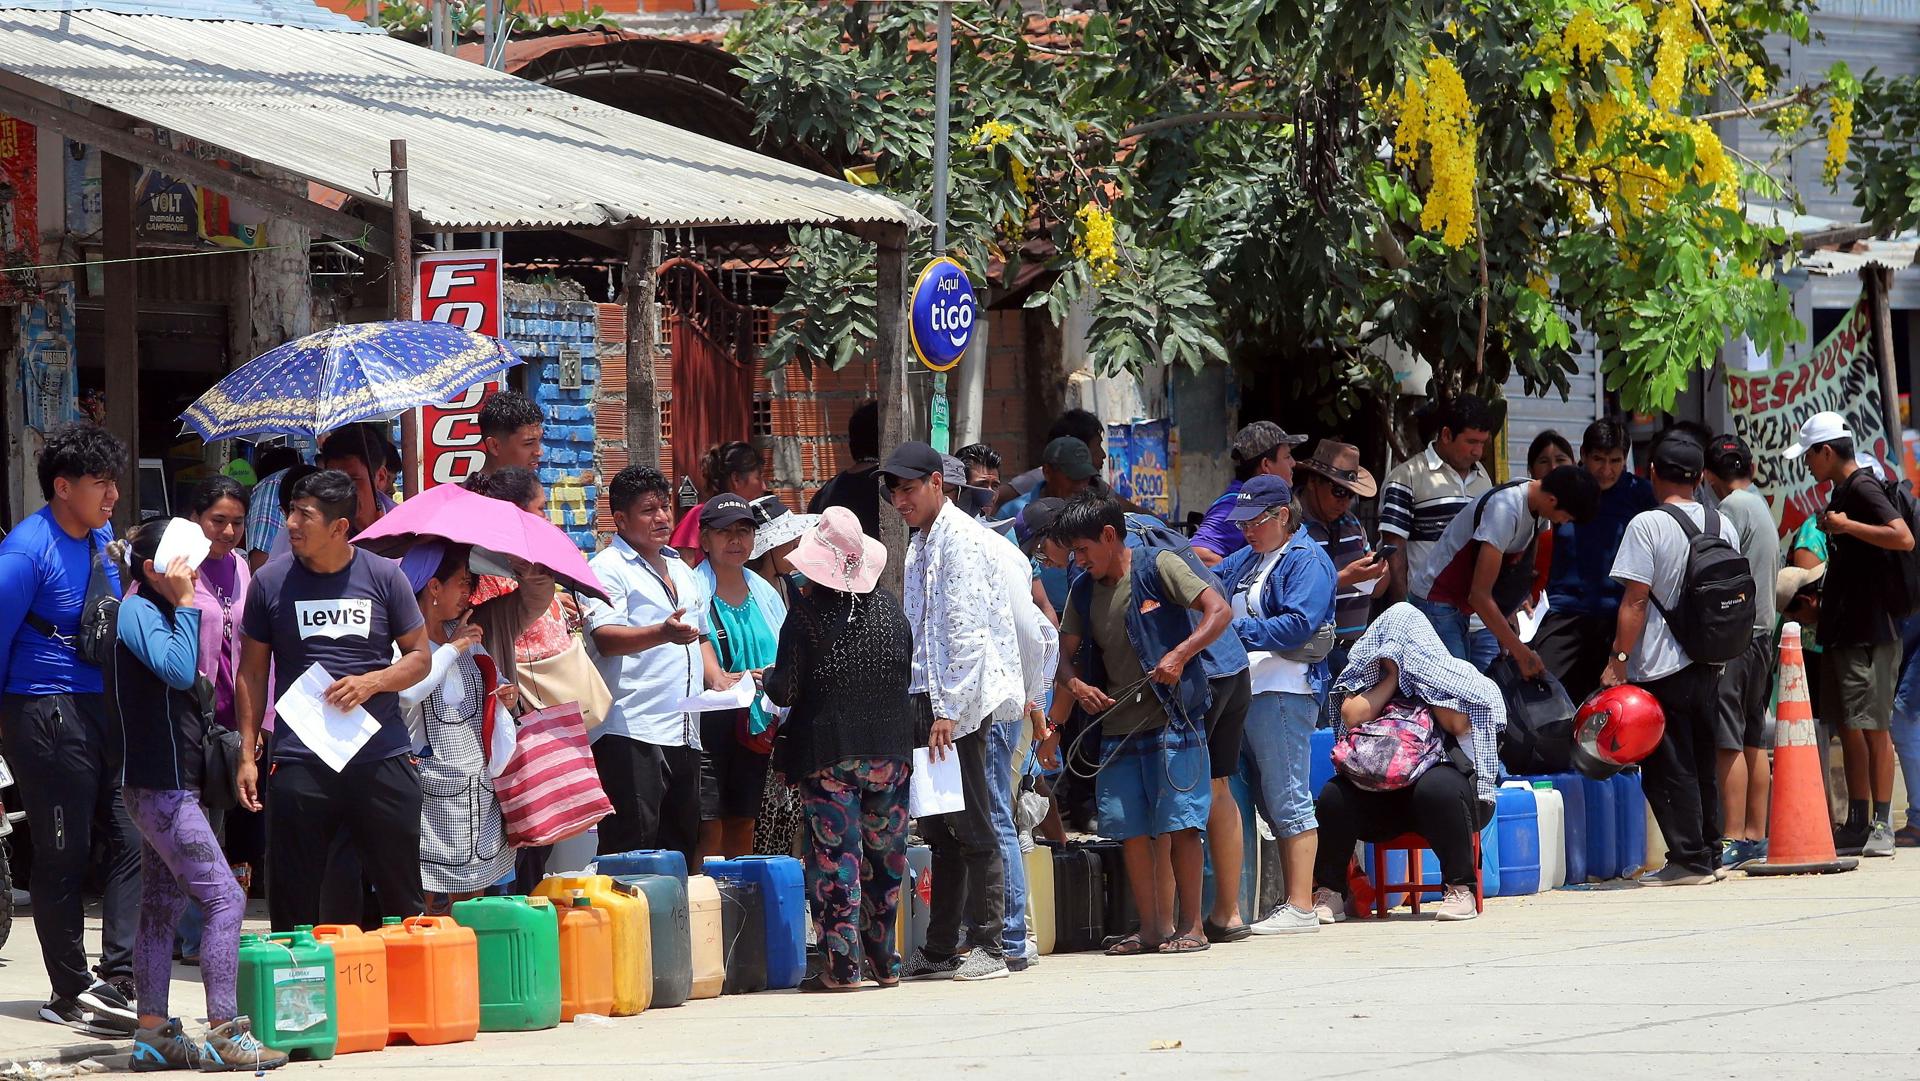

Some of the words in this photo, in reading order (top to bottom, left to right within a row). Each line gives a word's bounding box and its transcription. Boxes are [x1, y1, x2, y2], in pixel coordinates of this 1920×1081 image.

[150, 192, 182, 213] VOLT
[175, 215, 184, 223] DE
[937, 273, 960, 295] Aquí
[340, 963, 376, 985] 112
